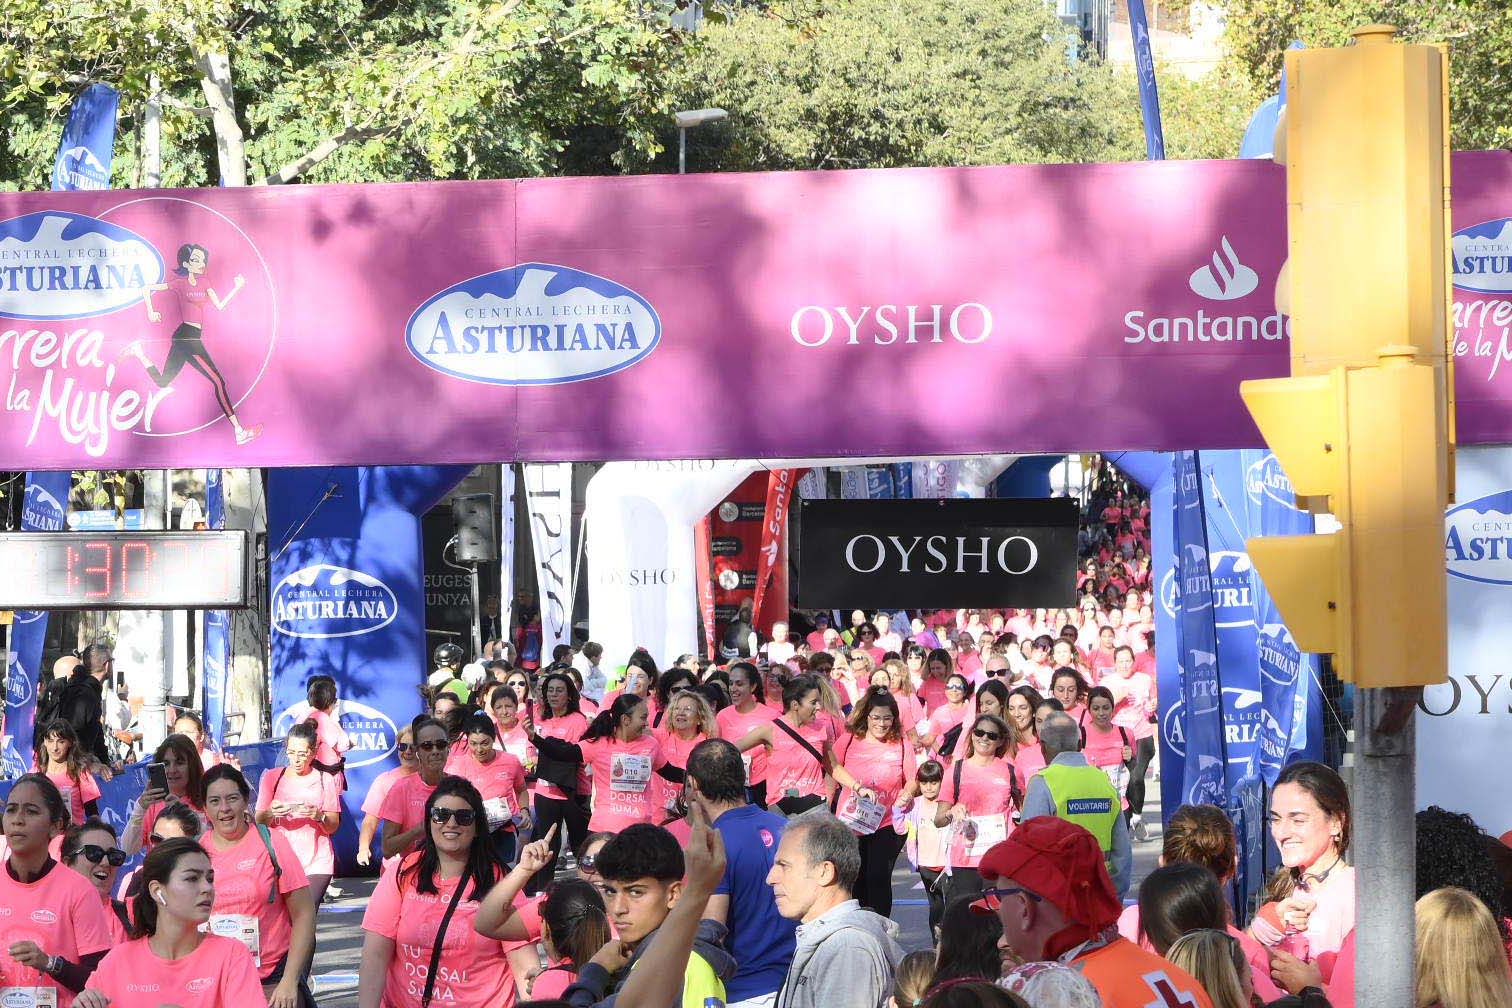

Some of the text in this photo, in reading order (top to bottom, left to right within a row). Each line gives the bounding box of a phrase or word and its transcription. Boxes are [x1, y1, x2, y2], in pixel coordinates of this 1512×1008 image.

[68, 246, 149, 258] LECHERA
[464, 304, 632, 319] CENTRAL LECHERA
[790, 302, 990, 347] OYSHO
[1124, 309, 1291, 344] Santand
[425, 311, 641, 355] ASTURIANA
[1475, 328, 1492, 357] la
[6, 371, 31, 412] la
[26, 364, 175, 456] Mujer
[845, 534, 1038, 575] OYSHO
[424, 575, 472, 587] EUGES
[288, 588, 383, 598] CENTRAL LECHERA
[427, 594, 472, 606] UNYA
[276, 595, 388, 622] ASTURIANA
[342, 721, 384, 729] ECHERA
[1068, 802, 1110, 811] VOLUNTARIS
[401, 943, 421, 958] TU
